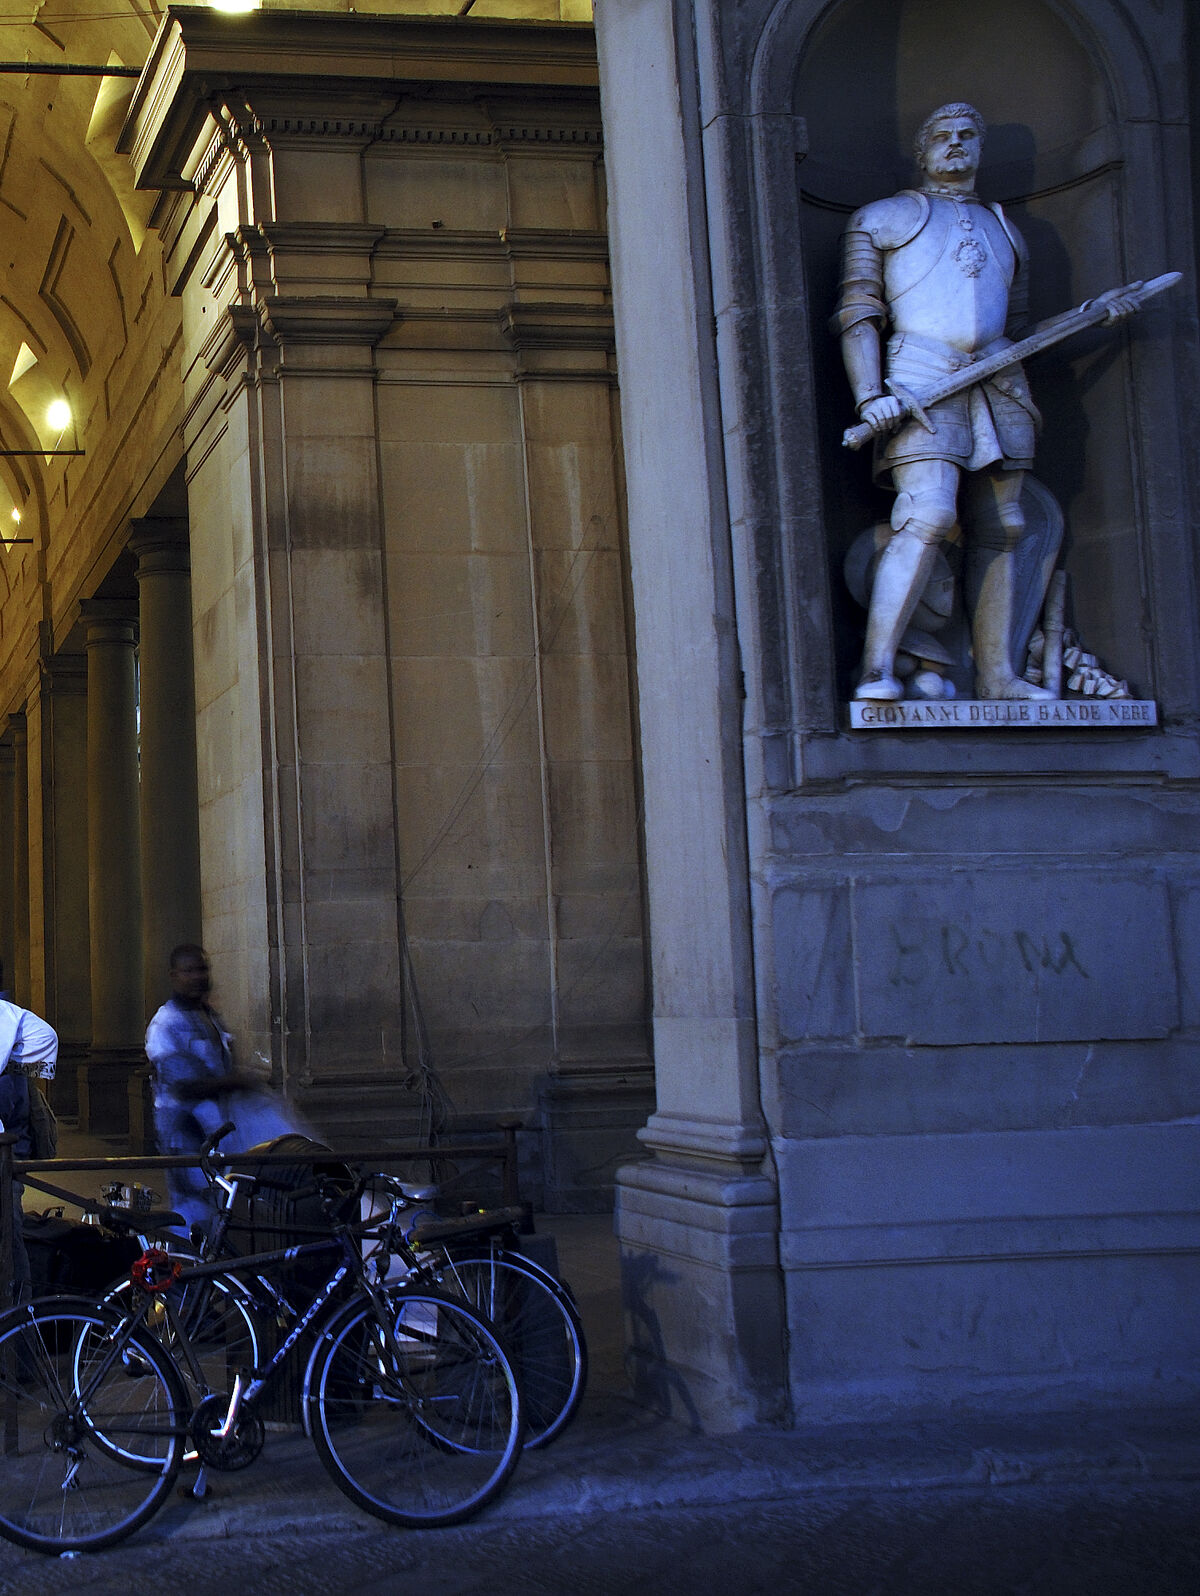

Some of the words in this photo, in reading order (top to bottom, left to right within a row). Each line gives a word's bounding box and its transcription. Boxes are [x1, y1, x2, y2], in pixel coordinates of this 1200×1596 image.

[861, 705, 960, 723] GIOVANNI
[969, 705, 1030, 722] DELLE
[1039, 705, 1100, 721] BANDE
[1109, 705, 1150, 721] NERE
